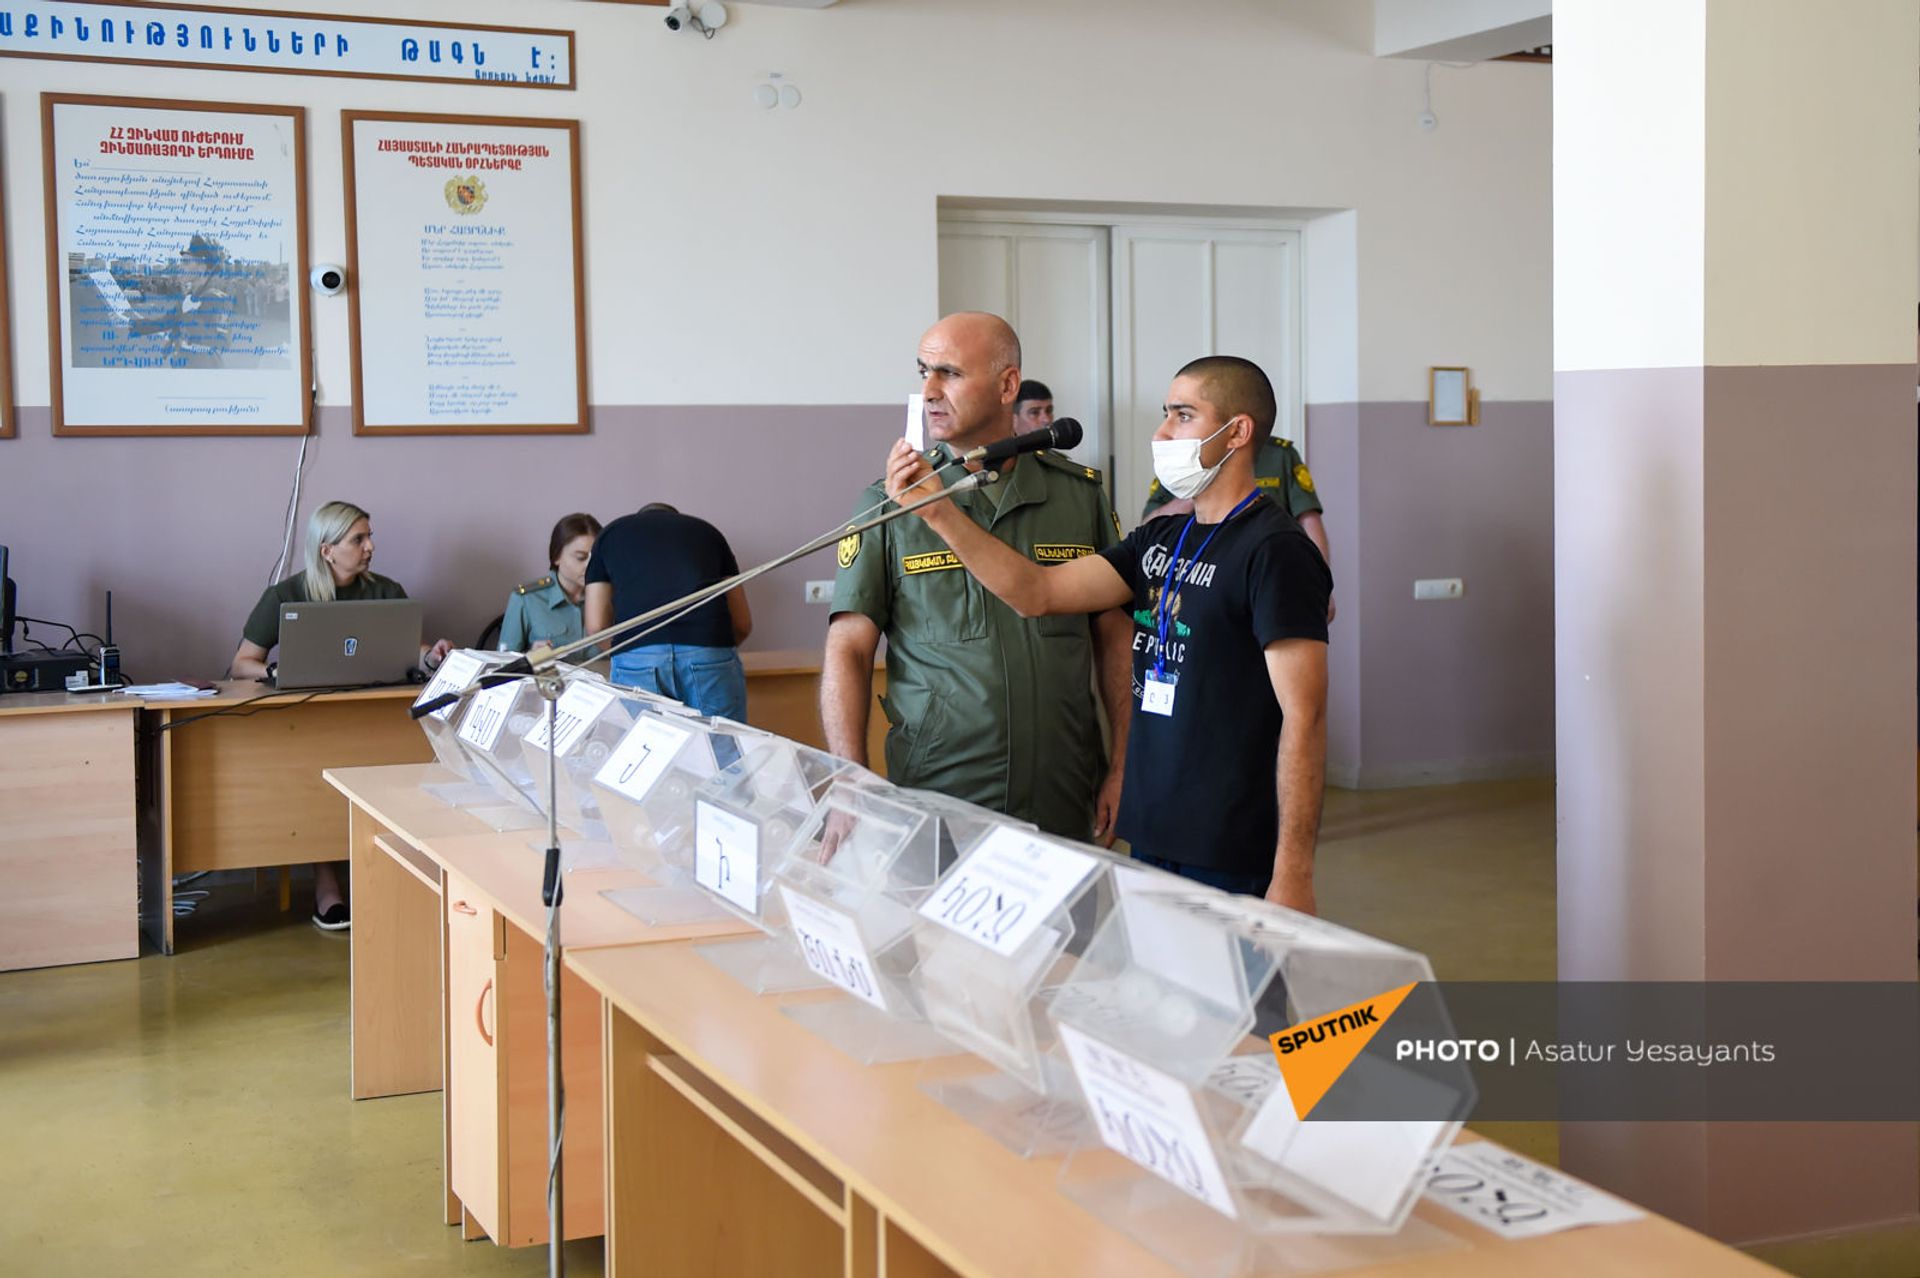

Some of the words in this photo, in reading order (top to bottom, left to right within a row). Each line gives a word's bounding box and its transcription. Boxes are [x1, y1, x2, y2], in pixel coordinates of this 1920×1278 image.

[401, 38, 485, 66] ԹԱԳՆ
[181, 131, 244, 146] ՈՒԺԵՐՈՒՄ
[198, 146, 255, 161] ԵՐԴՈՒՄԸ
[377, 139, 443, 154] ՀԱՅԱՍՏԱՆԻ
[445, 142, 550, 158] ՀԱՆՐԱՊԵՏՈՒԹՅԱՆ
[408, 155, 463, 169] ՊԵՏԱԿԱՆ
